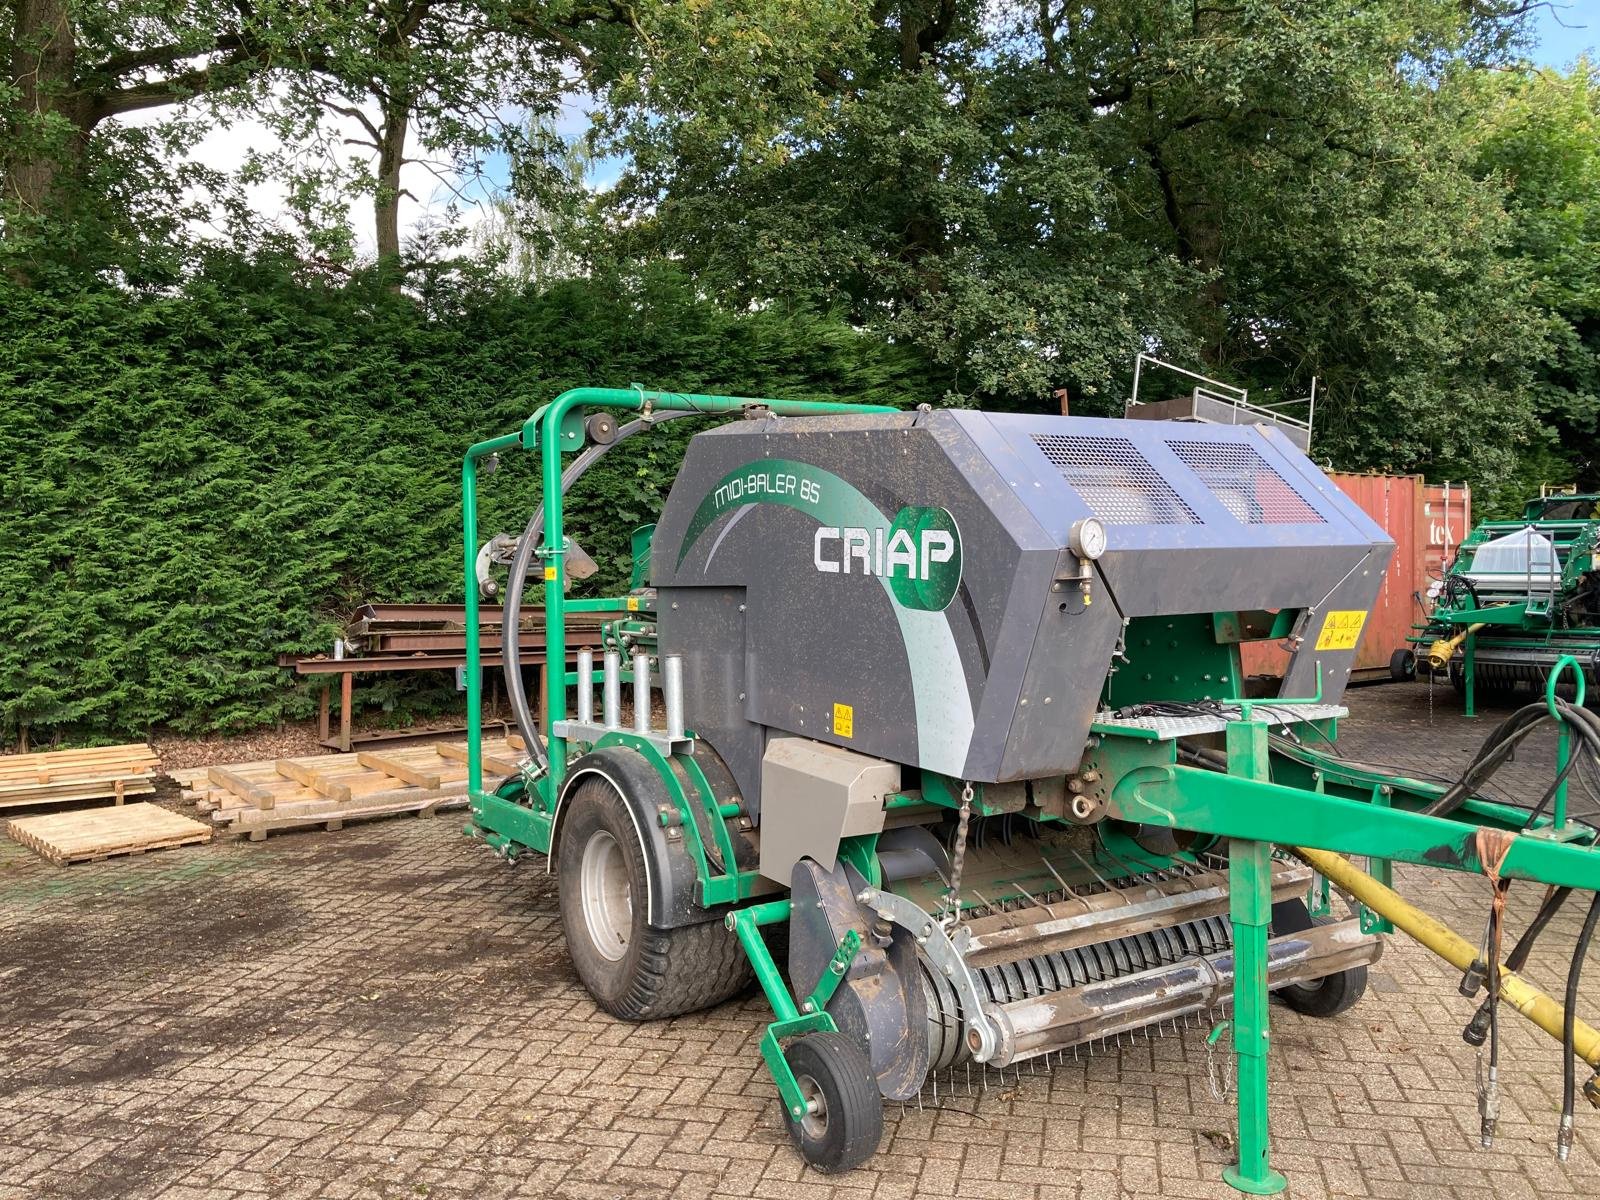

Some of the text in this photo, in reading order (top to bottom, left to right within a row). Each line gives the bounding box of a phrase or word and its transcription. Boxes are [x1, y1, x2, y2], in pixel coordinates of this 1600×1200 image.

[714, 473, 821, 509] MIDI-BALER 85
[813, 526, 955, 581] CRIAP
